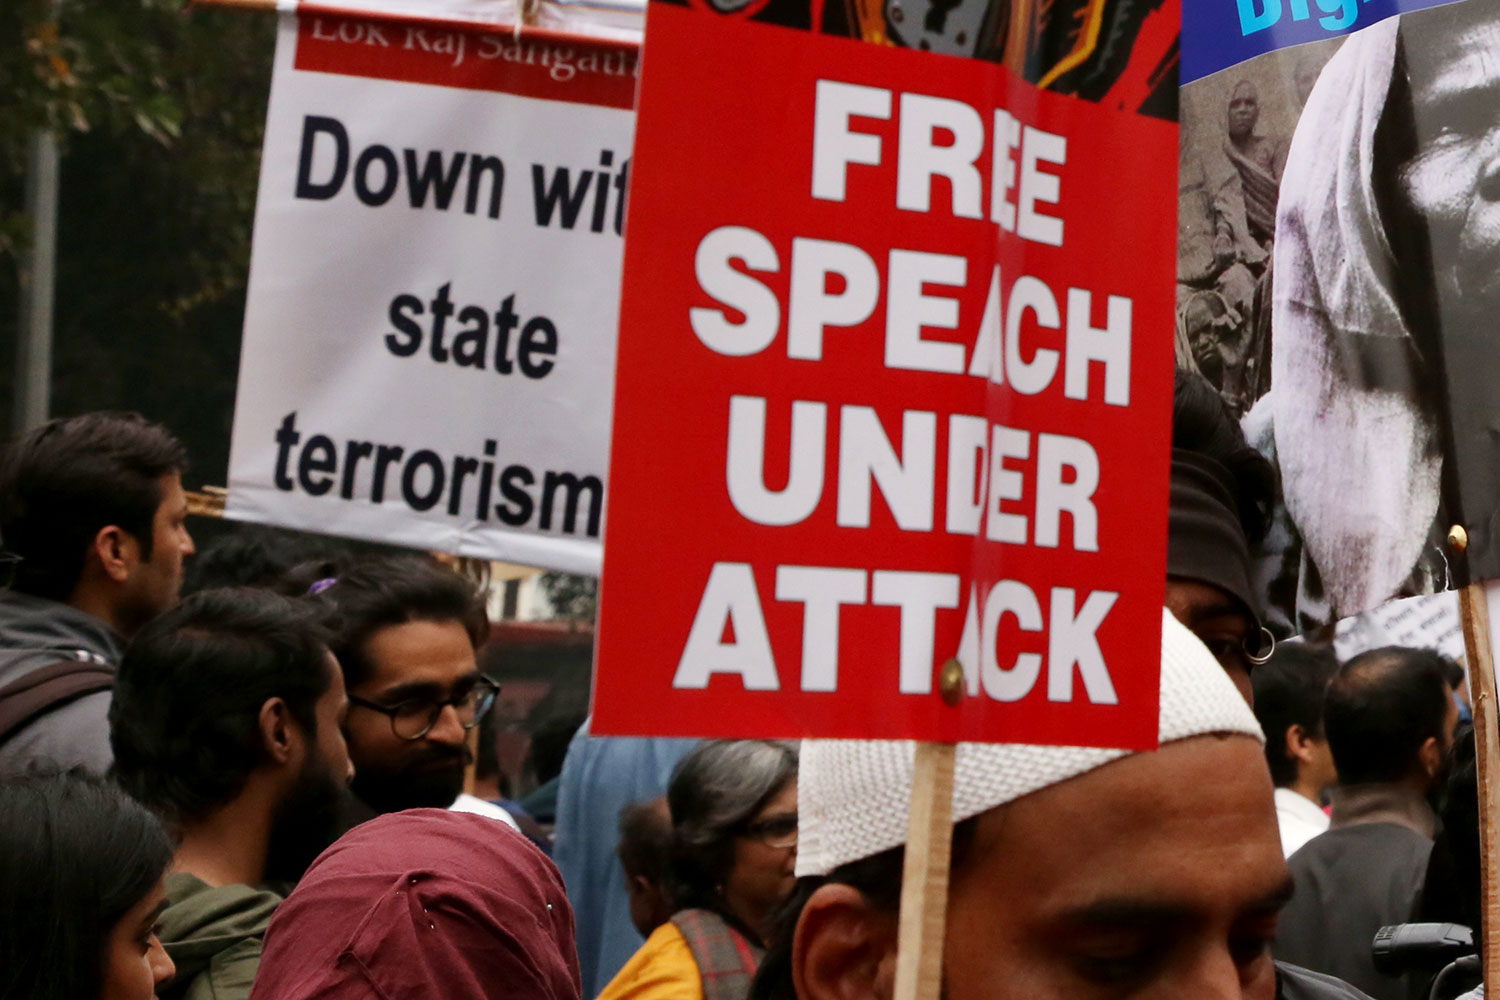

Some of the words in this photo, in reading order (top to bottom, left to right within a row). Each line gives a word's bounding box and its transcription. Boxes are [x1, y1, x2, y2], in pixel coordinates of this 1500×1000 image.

[295, 115, 505, 219] Down
[812, 80, 1066, 246] FREE
[385, 282, 558, 380] state
[274, 412, 604, 538] terrorism
[726, 396, 1099, 551] UNDER
